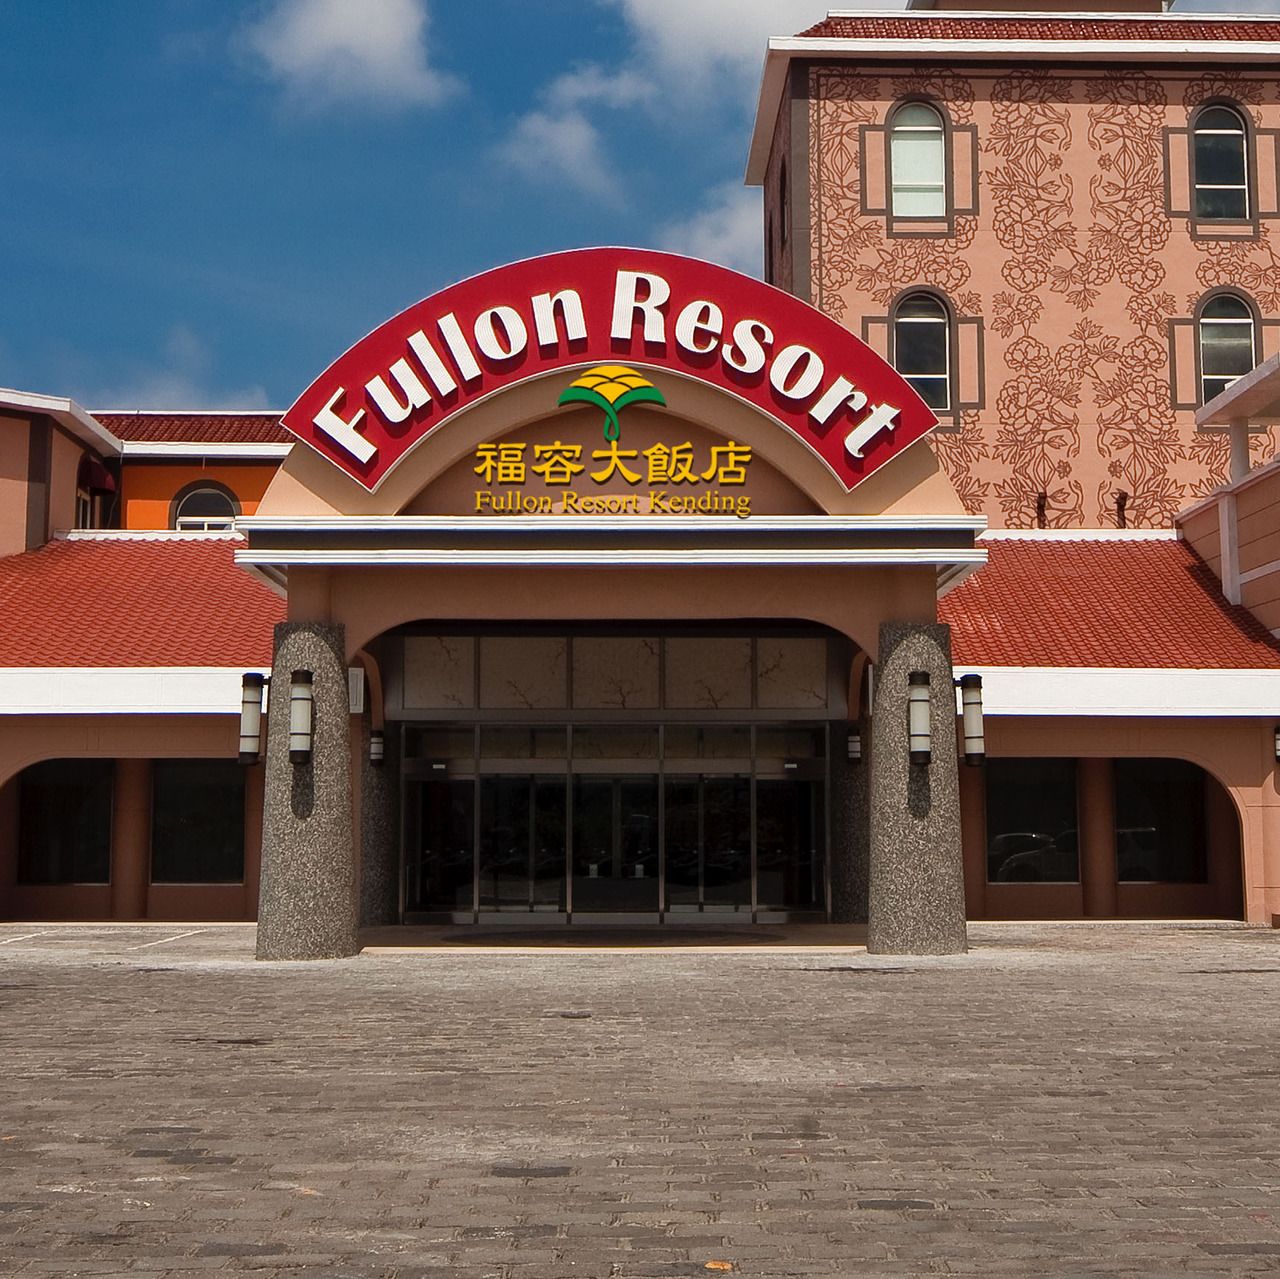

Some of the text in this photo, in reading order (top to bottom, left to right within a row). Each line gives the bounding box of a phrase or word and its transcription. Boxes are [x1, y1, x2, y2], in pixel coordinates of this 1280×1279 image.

[312, 269, 902, 465] Fullon Resort
[473, 439, 752, 484] 福容大飯店
[474, 489, 752, 516] Fullon Resort Kending
